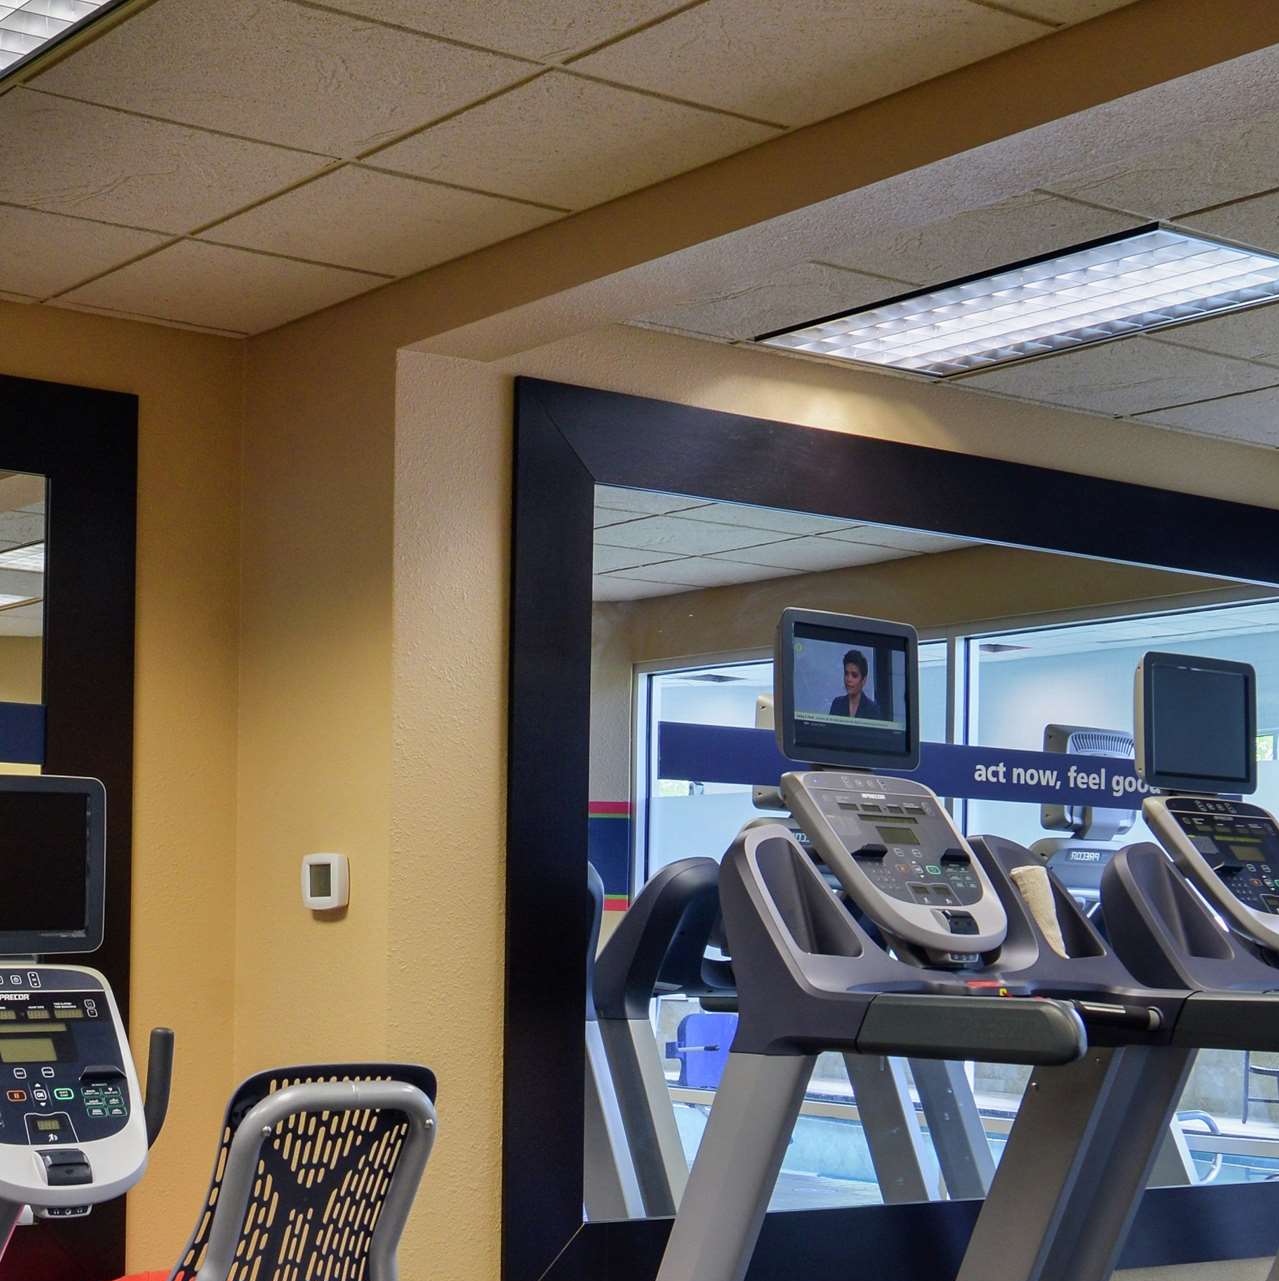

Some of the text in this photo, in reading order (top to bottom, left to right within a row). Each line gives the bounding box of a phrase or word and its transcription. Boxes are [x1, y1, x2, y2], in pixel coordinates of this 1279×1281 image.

[974, 762, 1007, 784] act
[1012, 767, 1062, 790] now,
[1068, 765, 1106, 790] feel
